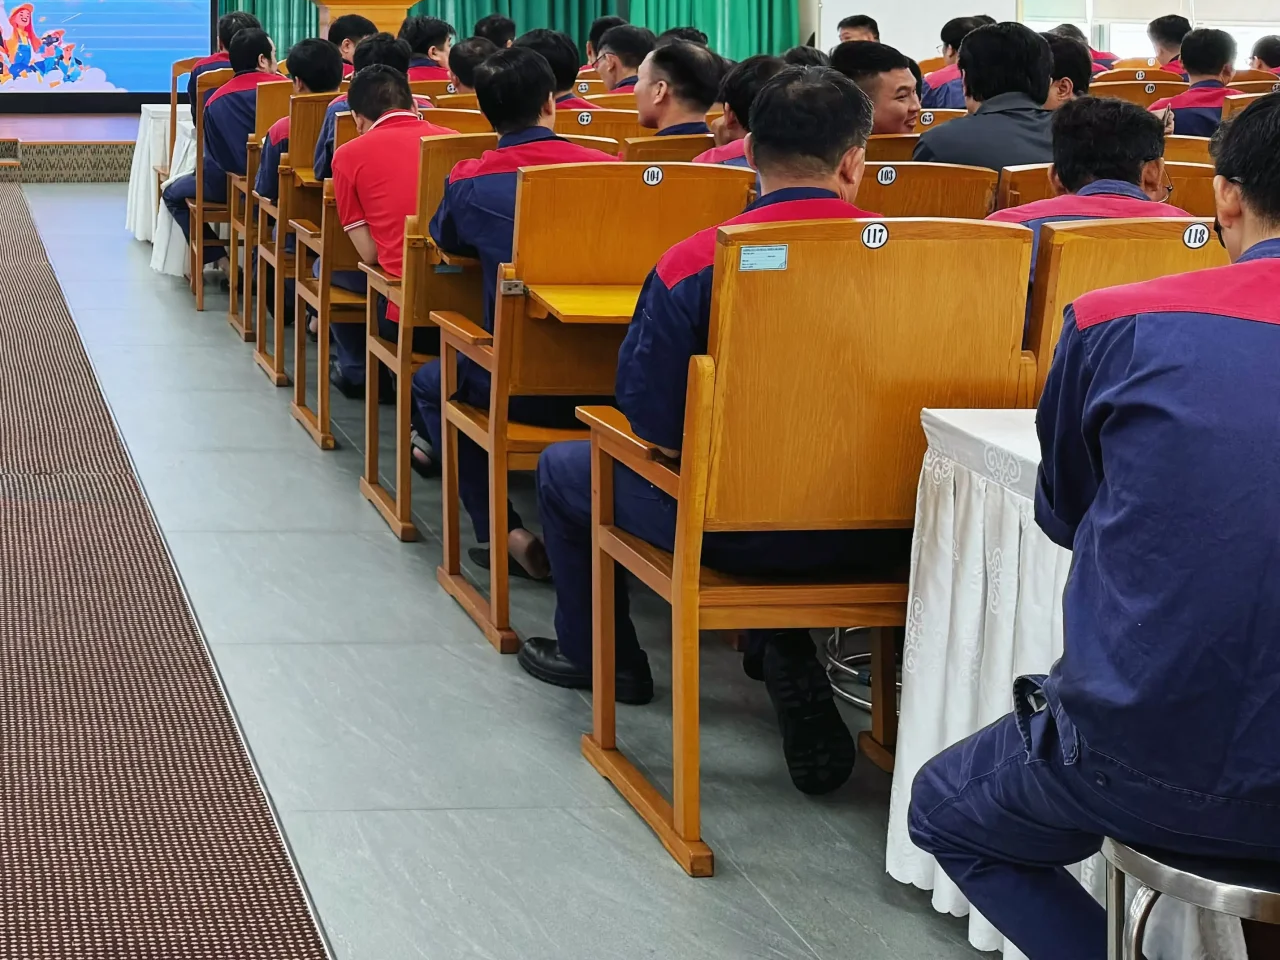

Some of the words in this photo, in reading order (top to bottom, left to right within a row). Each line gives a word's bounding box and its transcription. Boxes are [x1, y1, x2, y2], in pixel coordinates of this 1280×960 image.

[579, 114, 589, 122] 67
[922, 114, 932, 122] 65
[646, 170, 660, 182] 104
[880, 170, 893, 181] 103
[866, 228, 885, 243] 117
[1187, 228, 1205, 243] 118
